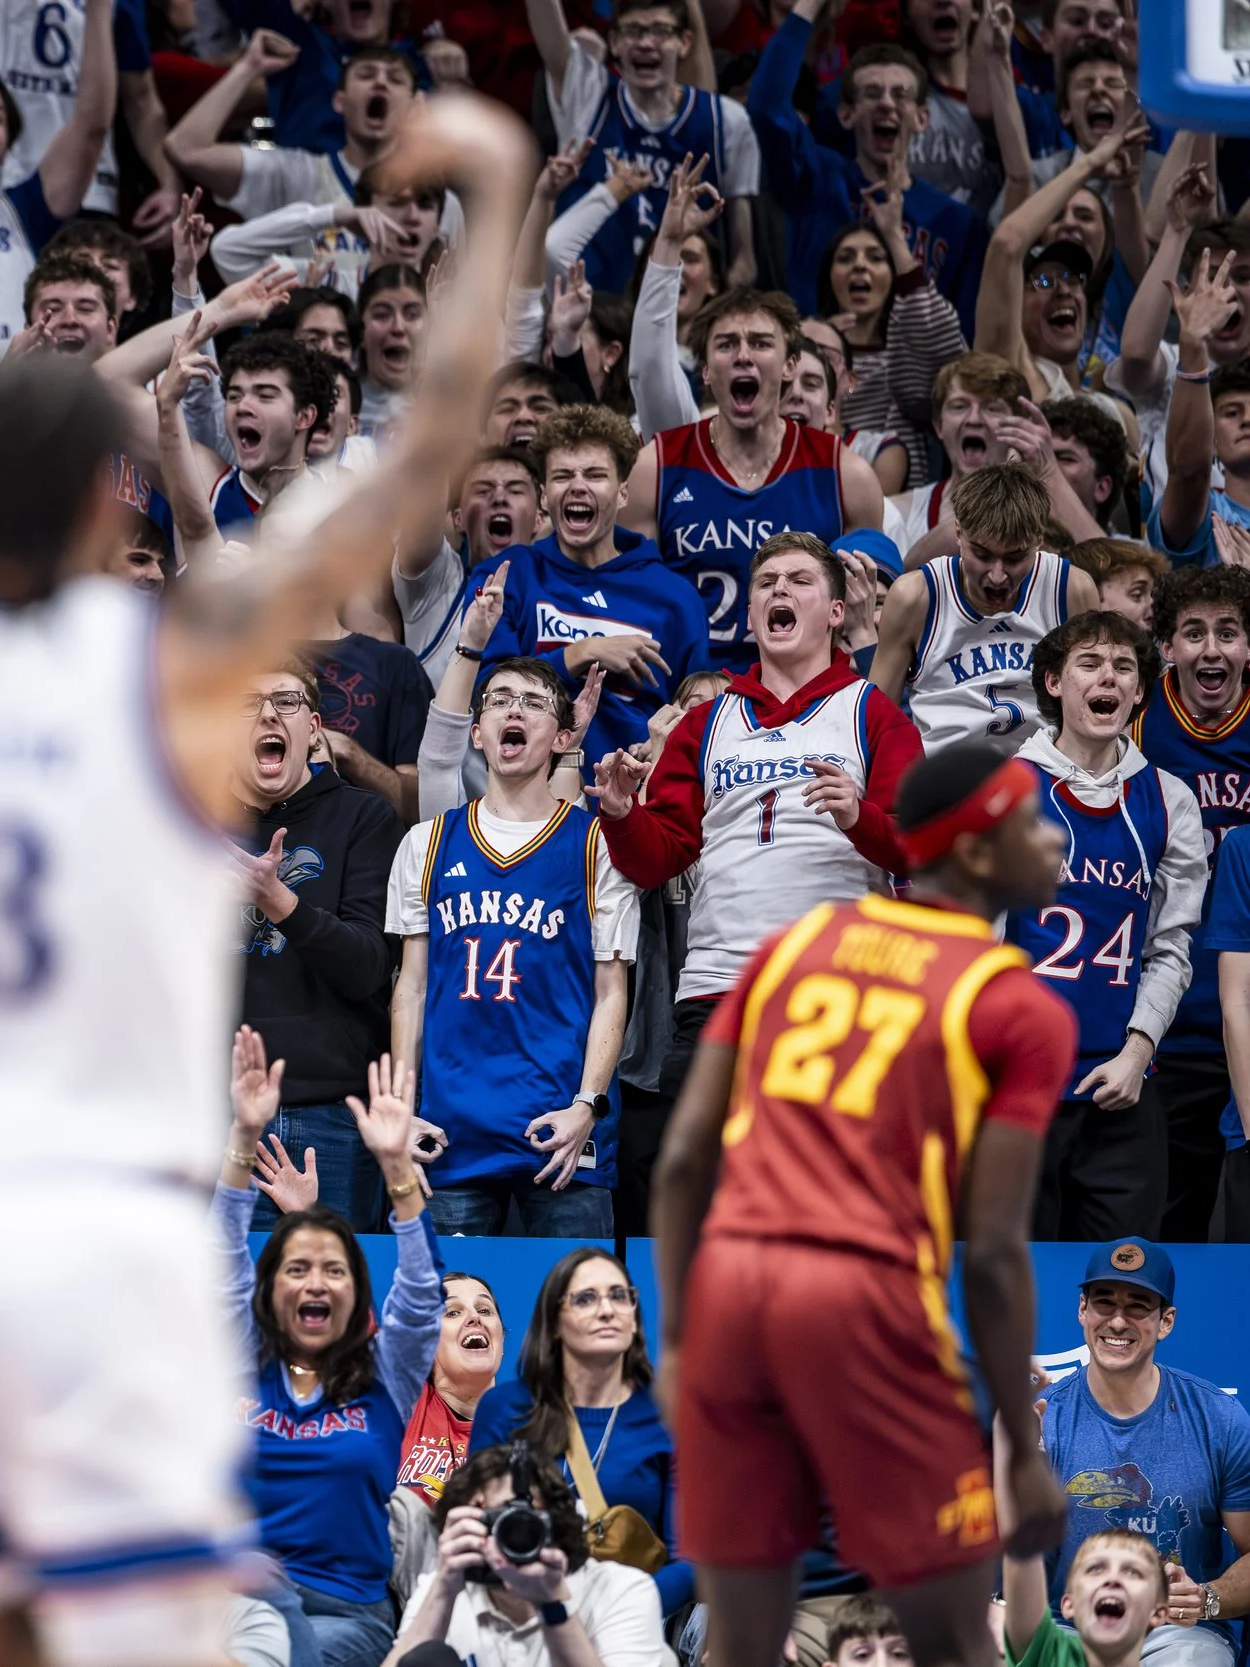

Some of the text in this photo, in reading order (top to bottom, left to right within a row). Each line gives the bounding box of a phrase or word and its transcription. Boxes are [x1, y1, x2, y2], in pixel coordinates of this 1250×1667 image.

[35, 3, 70, 68] 6
[674, 518, 817, 557] KANS
[697, 570, 757, 642] 2
[945, 642, 1039, 685] KANSA
[984, 684, 1027, 737] 5
[755, 787, 781, 846] 1
[1056, 858, 1150, 898] ANSA
[436, 890, 565, 940] KANSAS
[459, 937, 523, 1003] 14
[1031, 904, 1137, 987] 24
[761, 971, 927, 1119] 27
[234, 1396, 367, 1441] KANSAS
[1128, 1517, 1157, 1533] KU
